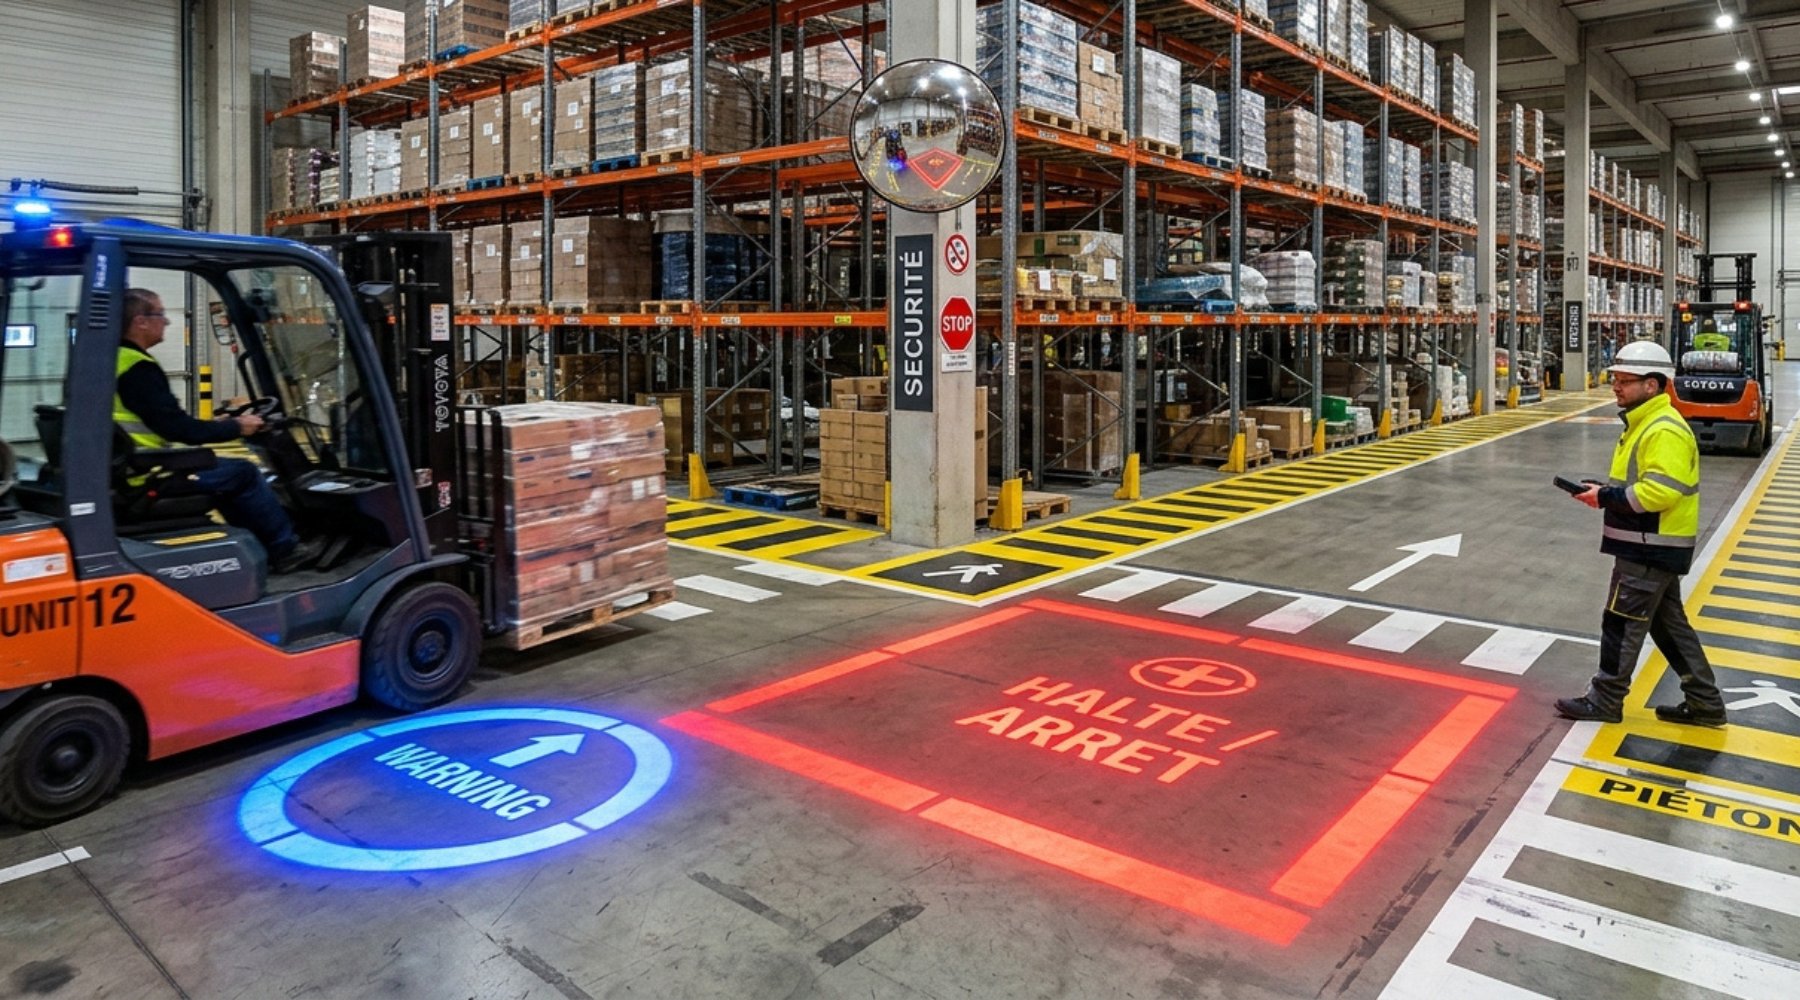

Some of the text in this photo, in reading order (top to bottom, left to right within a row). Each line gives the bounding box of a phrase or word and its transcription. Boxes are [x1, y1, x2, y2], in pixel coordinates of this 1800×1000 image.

[899, 251, 923, 396] SECURITÉ
[942, 315, 973, 333] STOP
[0, 583, 136, 637] UNIT 12
[955, 706, 1220, 783] ARRET
[1003, 676, 1231, 744] HALTE
[374, 743, 551, 820] WARNING
